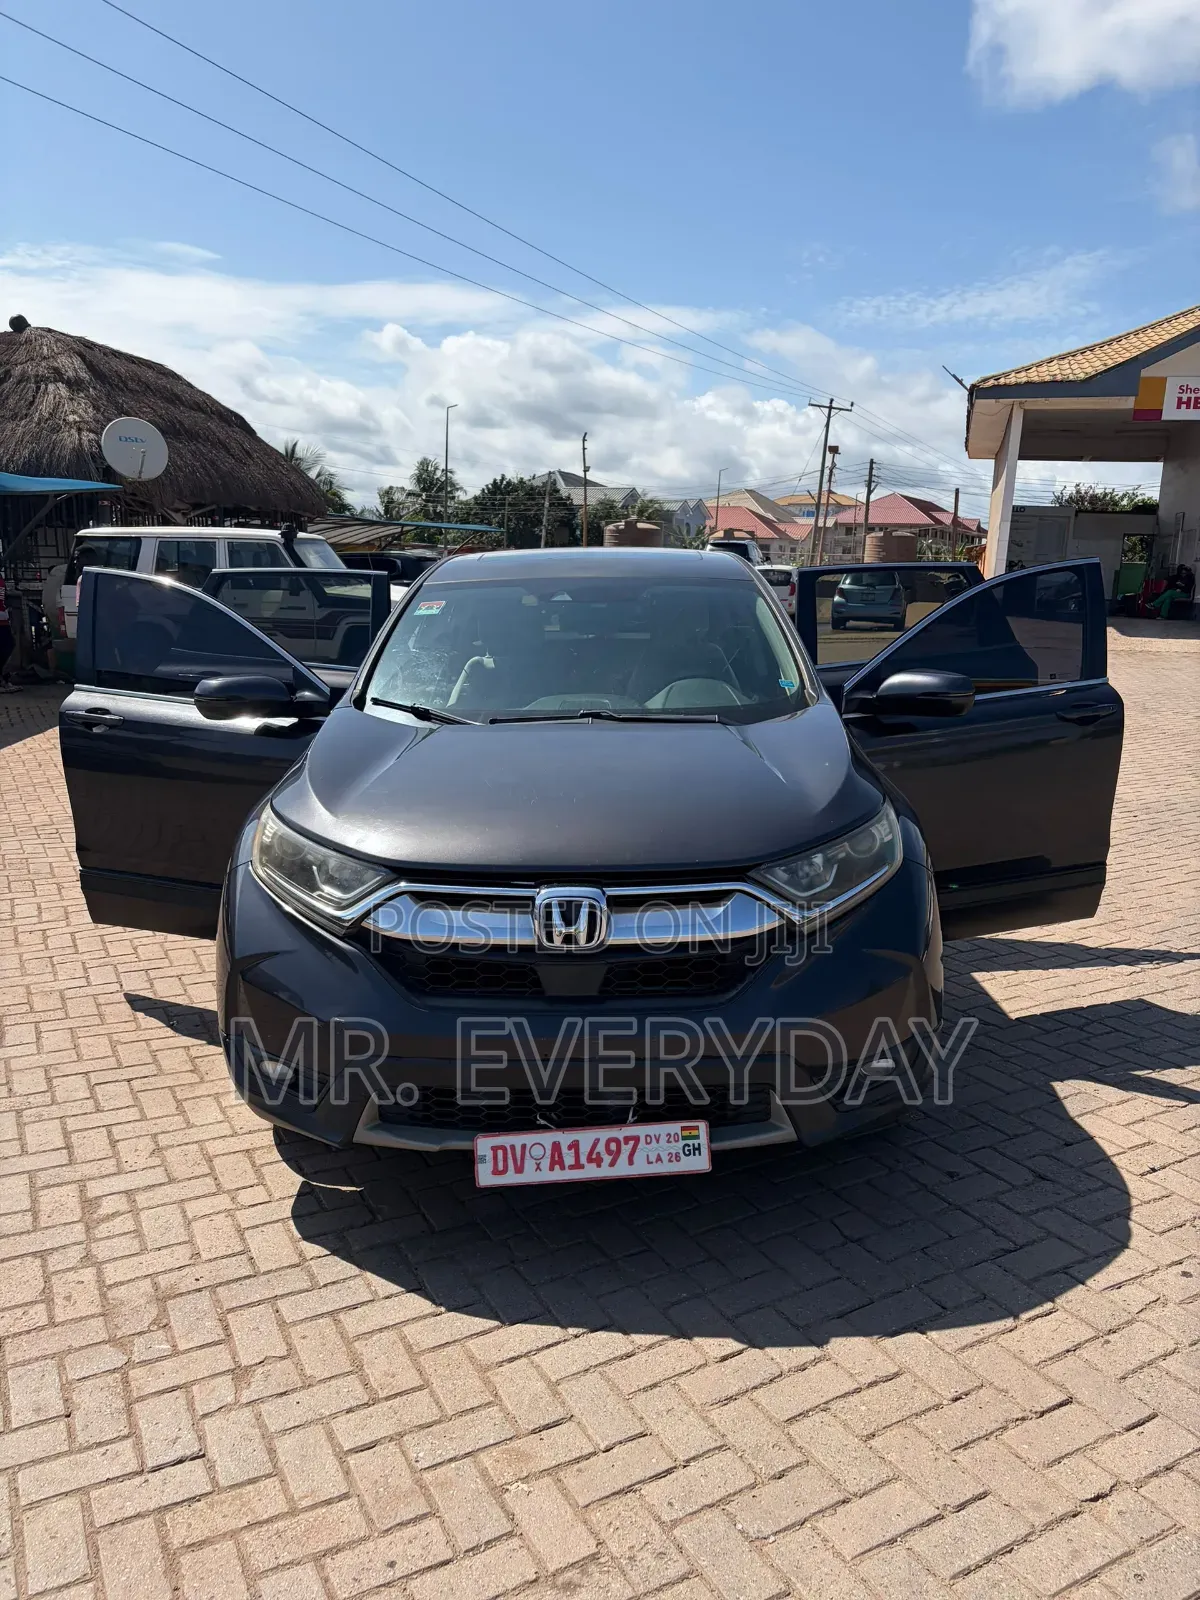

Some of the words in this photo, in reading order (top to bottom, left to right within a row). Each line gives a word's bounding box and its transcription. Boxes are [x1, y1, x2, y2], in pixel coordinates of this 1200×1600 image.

[644, 1133, 662, 1146] DV
[665, 1132, 680, 1144] 20
[490, 1143, 527, 1176] DV
[548, 1135, 641, 1172] A1497
[682, 1142, 702, 1158] GH
[646, 1152, 664, 1165] LA
